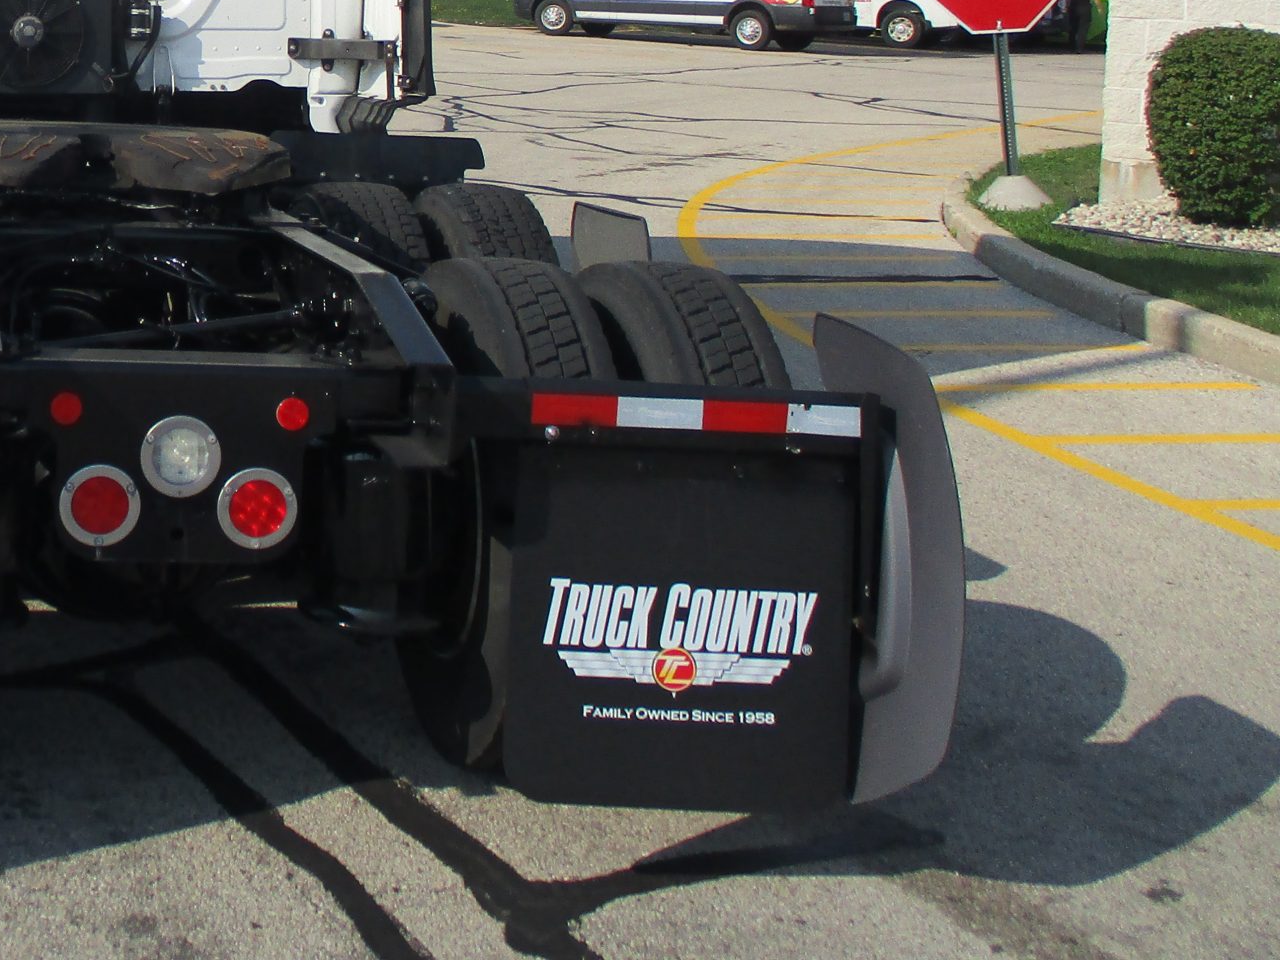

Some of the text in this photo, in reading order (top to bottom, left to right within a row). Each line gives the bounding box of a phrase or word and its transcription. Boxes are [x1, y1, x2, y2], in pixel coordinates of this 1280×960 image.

[543, 578, 818, 655] TRUCK COUNTRY
[582, 705, 775, 725] FAMILY OWNED SINCE 1958
